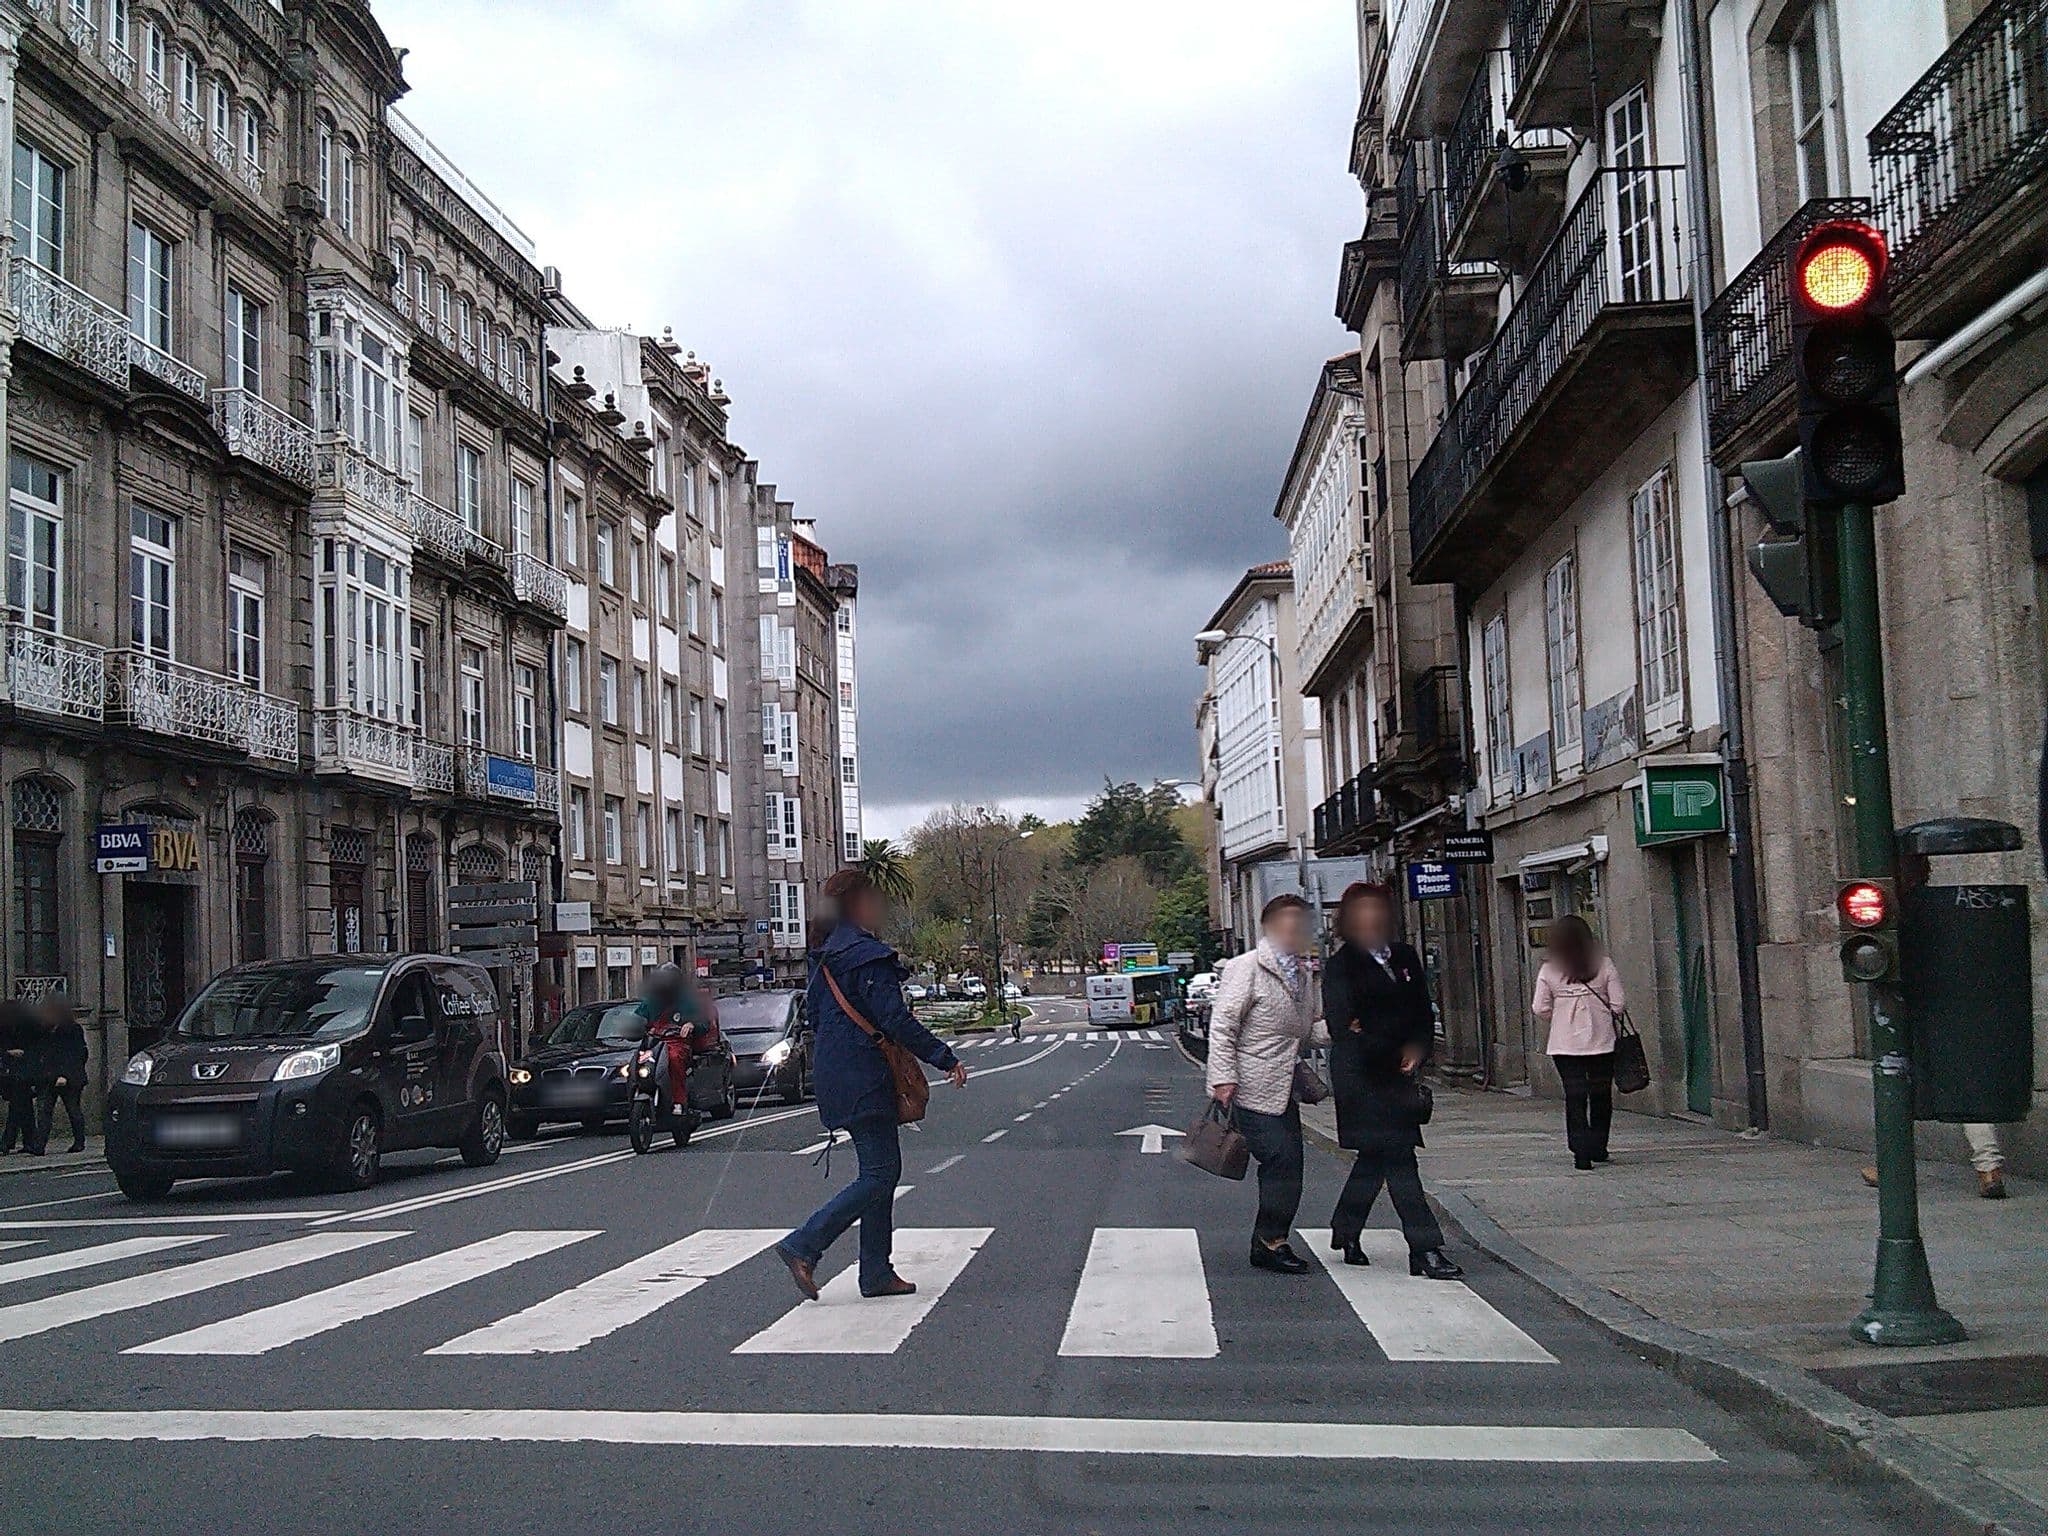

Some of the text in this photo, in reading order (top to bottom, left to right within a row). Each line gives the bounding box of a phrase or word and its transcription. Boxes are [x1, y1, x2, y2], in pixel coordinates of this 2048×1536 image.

[488, 784, 536, 801] ARQUITECTURA
[100, 833, 142, 848] BBVA
[1421, 863, 1443, 873] The
[1416, 874, 1451, 884] Phone
[1417, 884, 1452, 894] House
[440, 994, 471, 1016] Coffee
